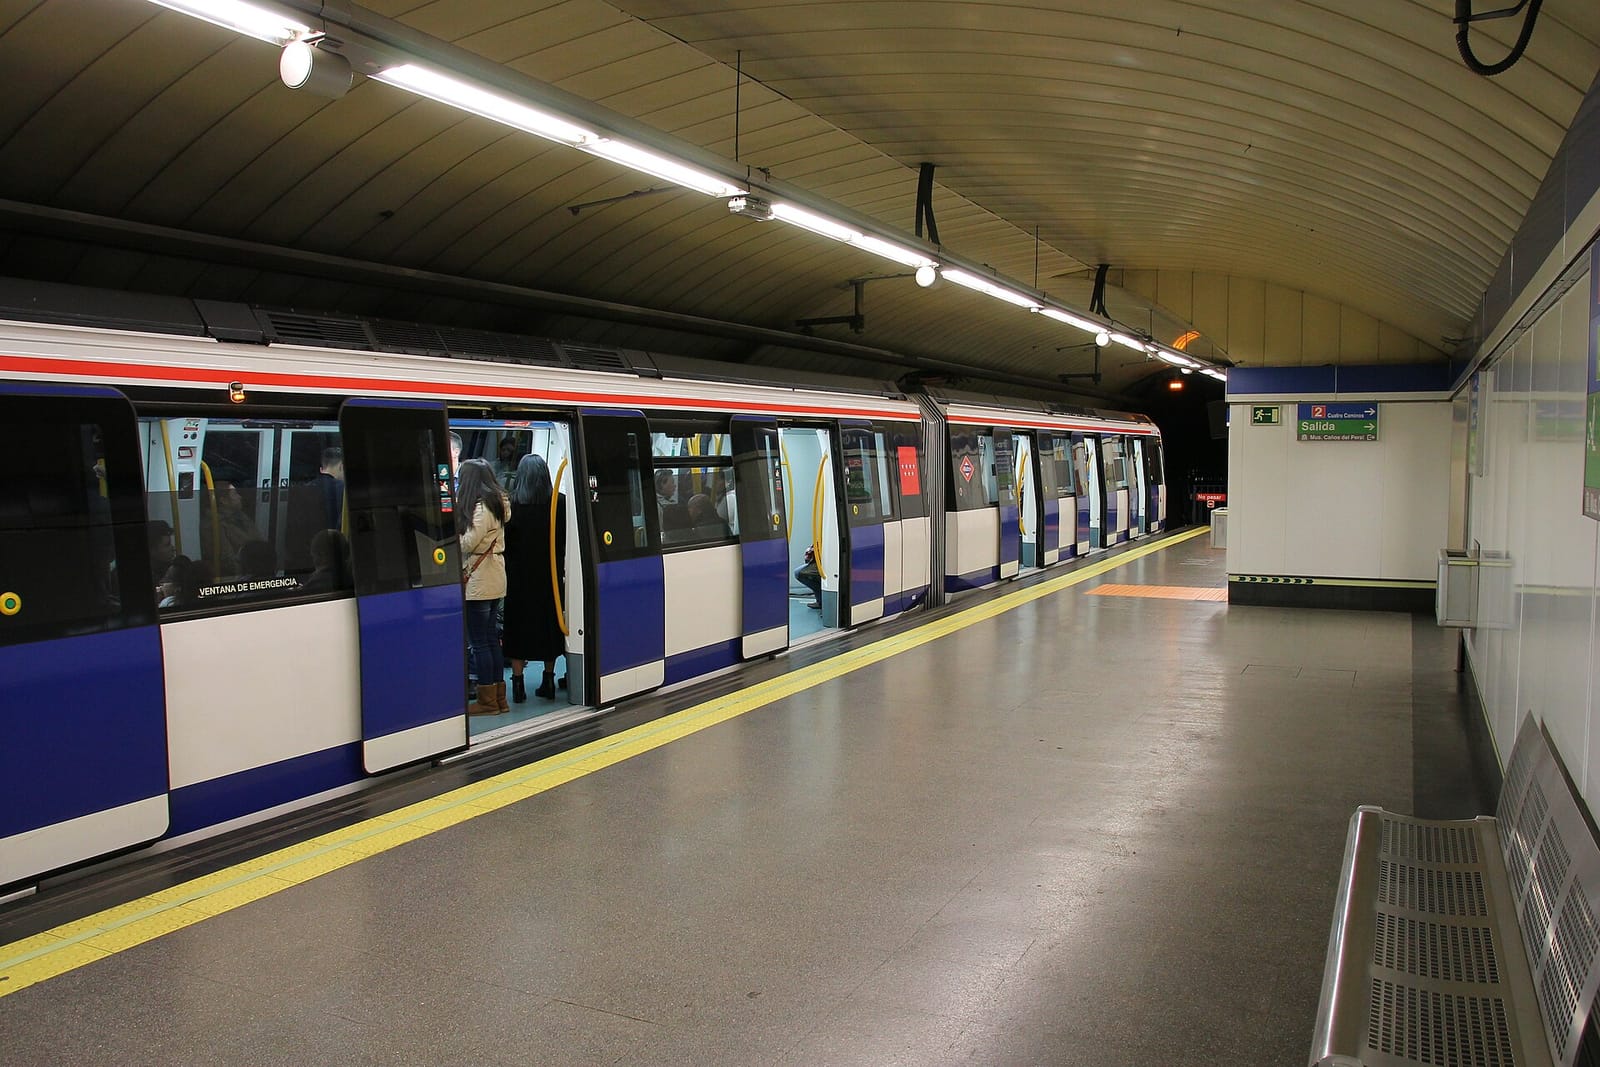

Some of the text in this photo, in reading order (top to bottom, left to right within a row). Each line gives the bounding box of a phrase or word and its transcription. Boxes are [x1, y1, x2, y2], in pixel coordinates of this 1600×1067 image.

[1314, 406, 1323, 417] 2
[1302, 422, 1335, 431] Salida
[200, 578, 297, 596] VENTANA DE EMERGENCIA
